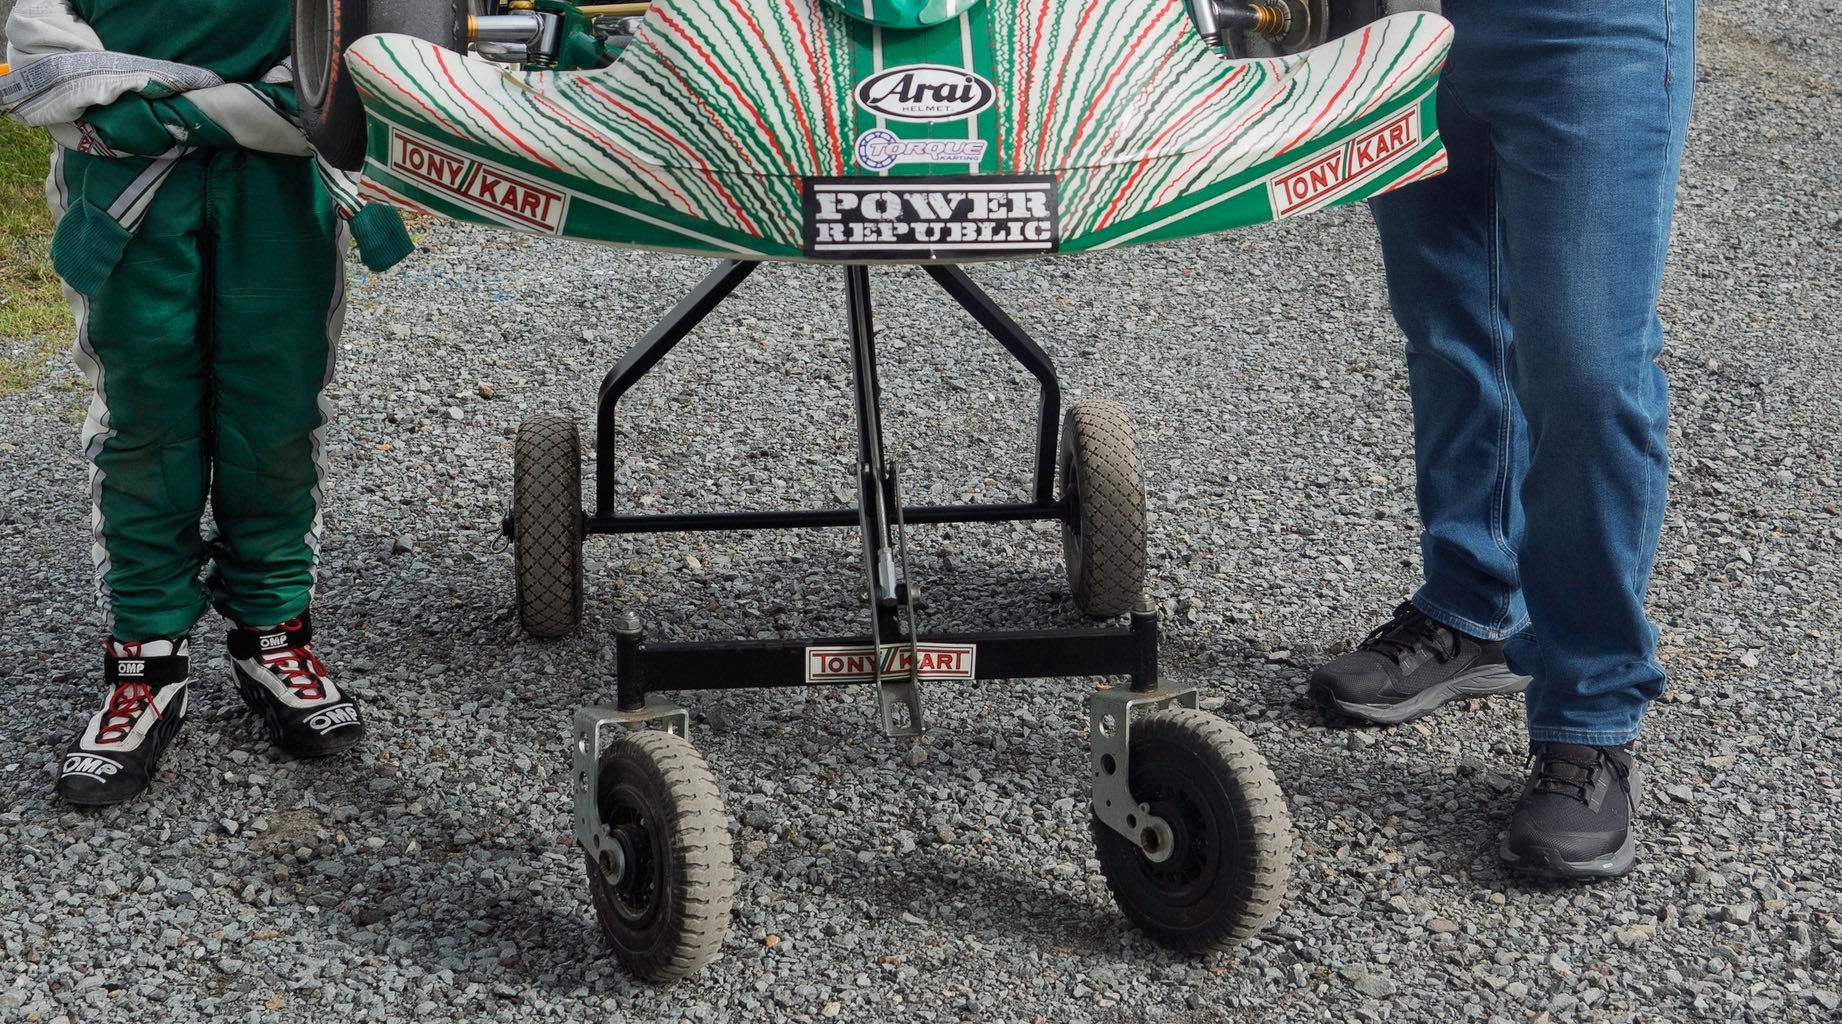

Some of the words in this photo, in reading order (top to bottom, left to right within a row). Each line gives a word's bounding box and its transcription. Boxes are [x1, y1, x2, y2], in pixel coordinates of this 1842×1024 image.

[868, 73, 977, 104] Arai
[869, 141, 986, 160] TORQUE
[815, 191, 1051, 222] POWER
[815, 220, 1052, 243] REPUBLIC
[260, 635, 287, 647] OMP
[118, 663, 144, 674] OMP
[309, 708, 359, 730] OMP
[62, 756, 119, 776] OMP
